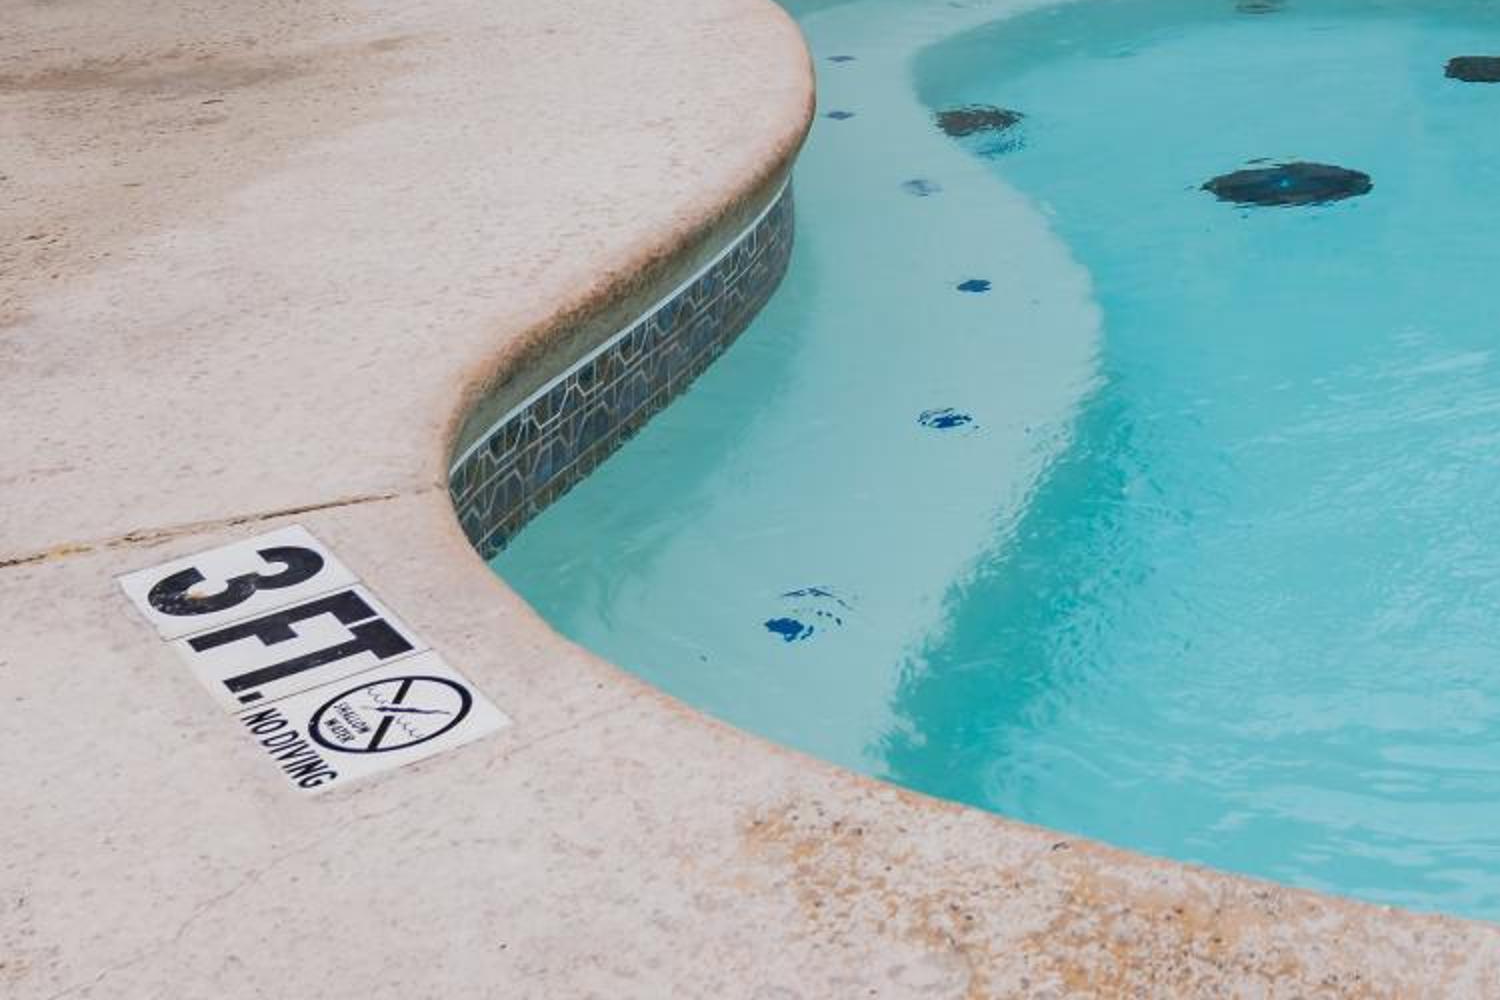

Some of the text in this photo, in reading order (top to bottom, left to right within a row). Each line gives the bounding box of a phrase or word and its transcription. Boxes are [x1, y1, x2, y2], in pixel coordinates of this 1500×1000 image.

[147, 546, 325, 617] 3
[240, 707, 338, 788] NO DIVING
